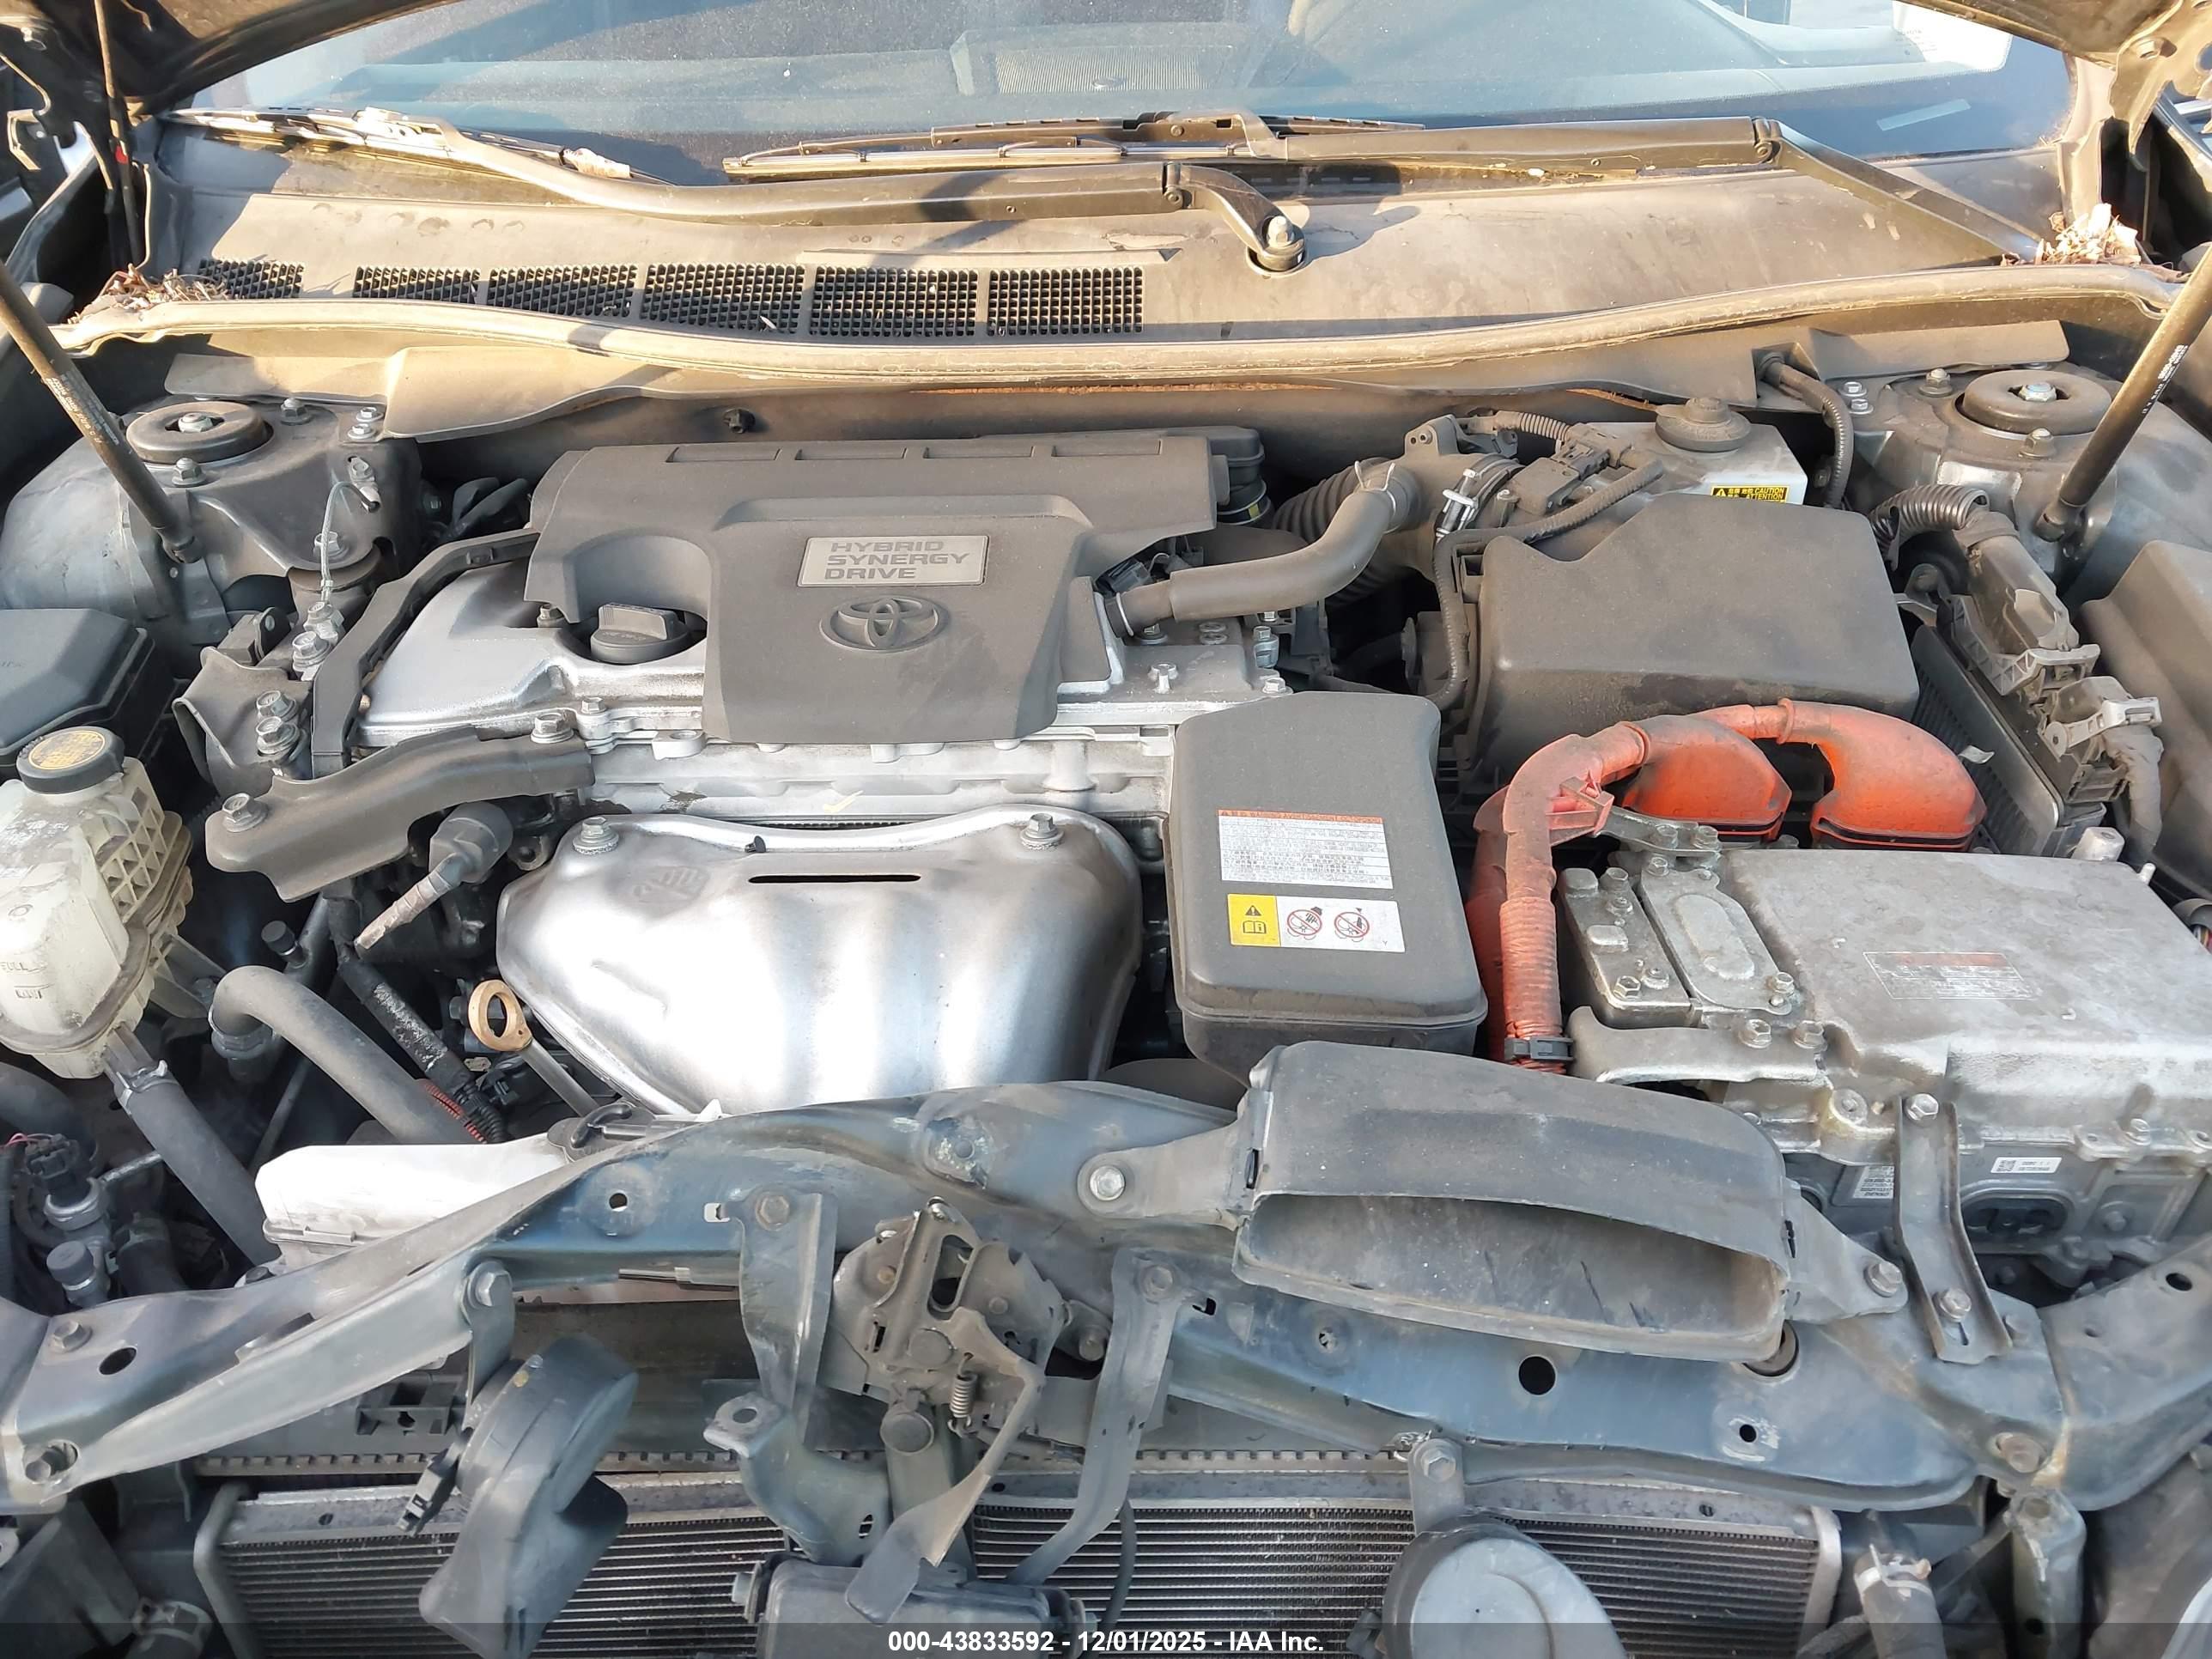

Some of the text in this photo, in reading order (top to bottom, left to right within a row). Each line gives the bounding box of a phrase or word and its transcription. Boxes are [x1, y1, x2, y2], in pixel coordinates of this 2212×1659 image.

[830, 541, 945, 552] HYBRID
[827, 553, 970, 566] SYNERGY
[824, 568, 918, 580] DRIVE
